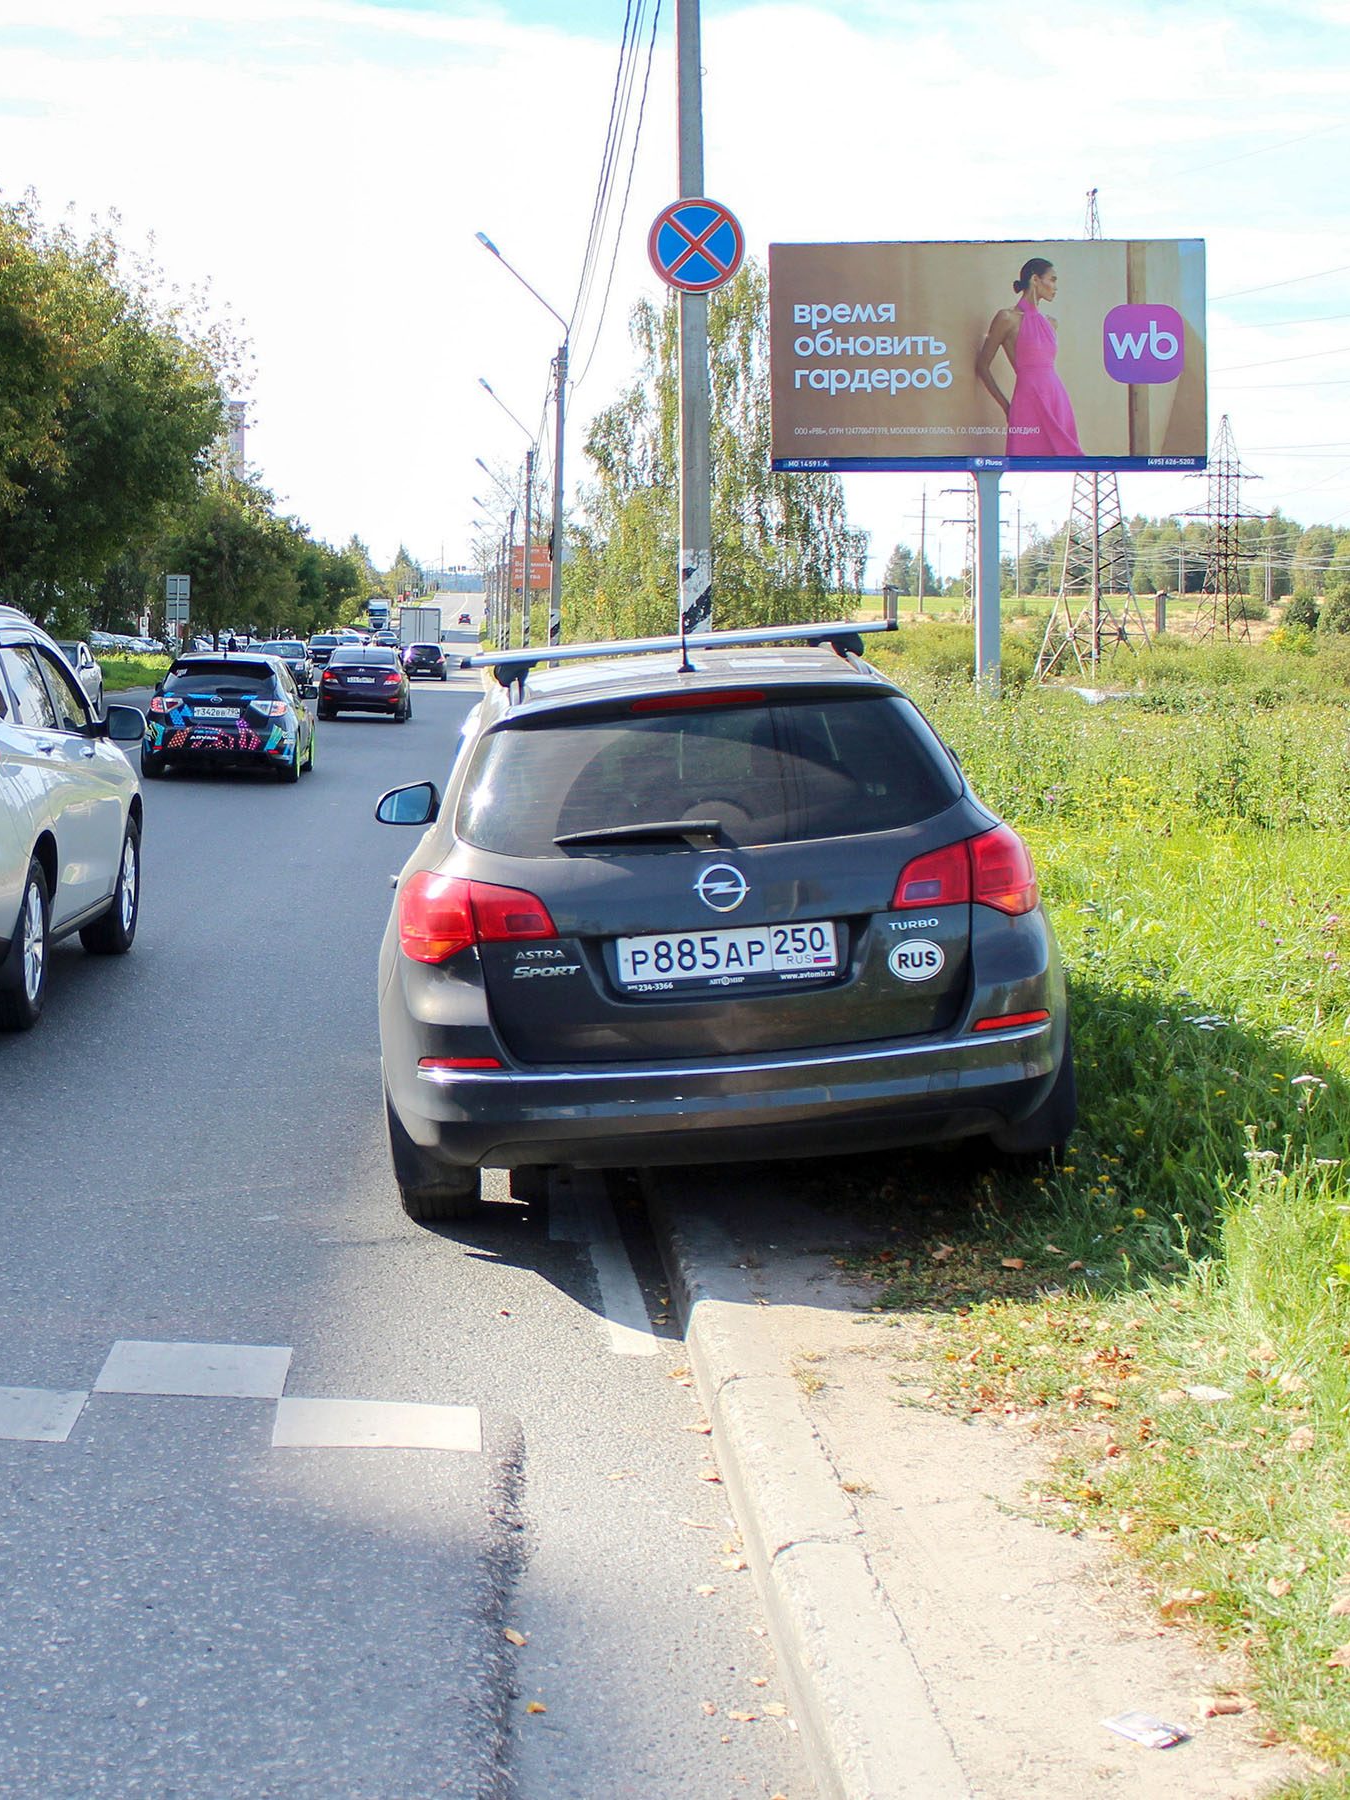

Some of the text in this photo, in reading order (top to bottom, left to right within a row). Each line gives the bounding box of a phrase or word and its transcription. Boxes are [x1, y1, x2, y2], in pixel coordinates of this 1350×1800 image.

[793, 303, 896, 330] время
[793, 328, 947, 357] обновить
[1108, 320, 1179, 360] wb
[794, 360, 953, 396] гардероб
[888, 917, 939, 931] TURBO
[515, 949, 566, 961] ASTRA
[631, 926, 825, 976] Р885АР 250
[786, 954, 813, 965] RUS
[897, 950, 938, 969] RUS
[779, 970, 836, 981] www.avtomir.ru
[638, 981, 674, 992] 234-3366
